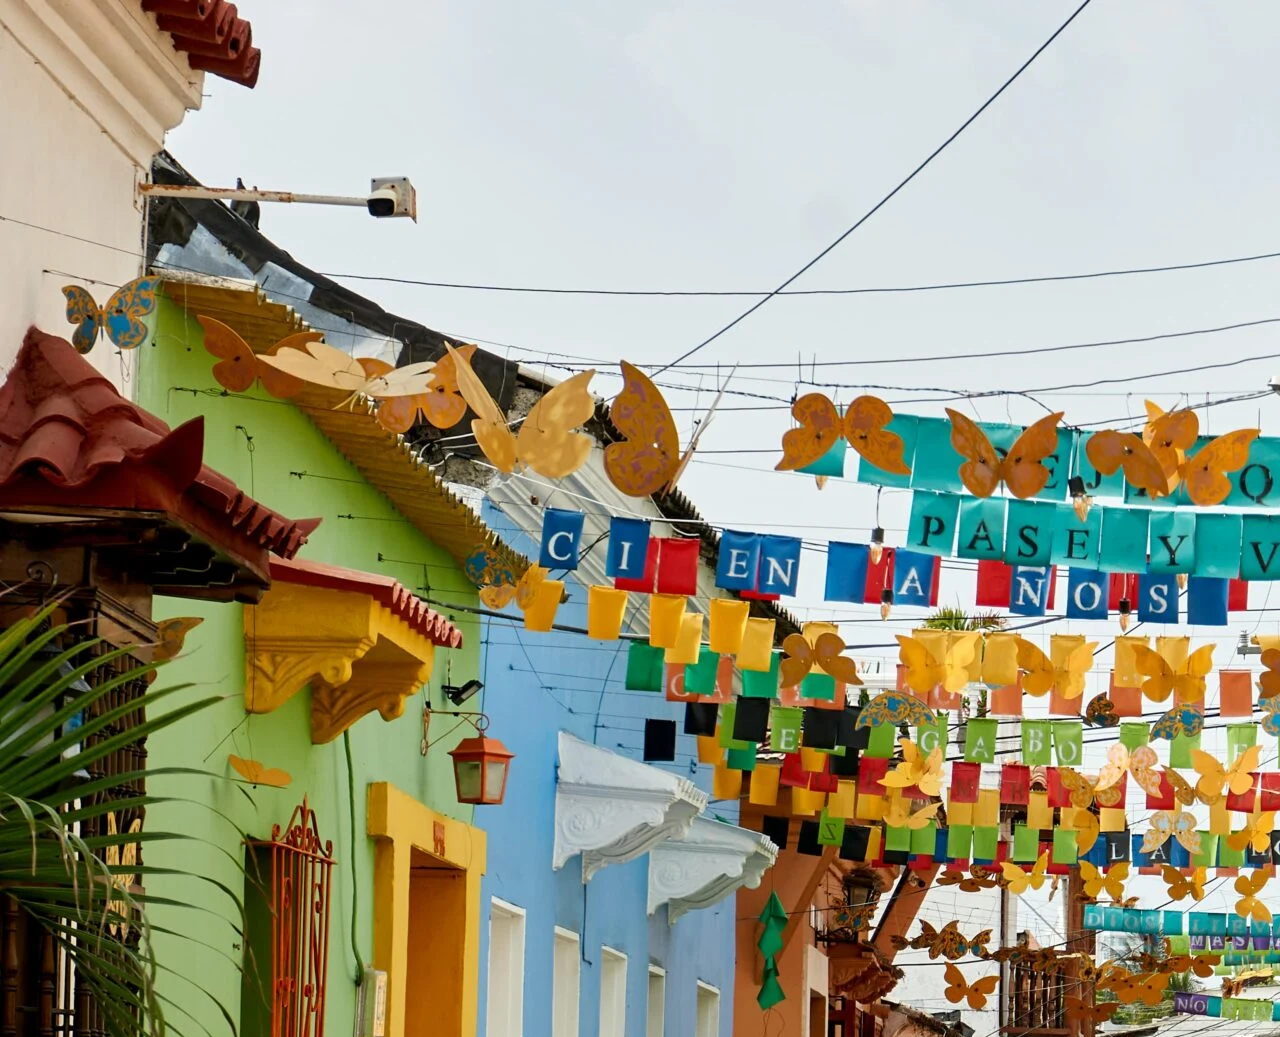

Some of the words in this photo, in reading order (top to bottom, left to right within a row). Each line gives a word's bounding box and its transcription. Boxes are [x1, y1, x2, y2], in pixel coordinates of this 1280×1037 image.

[917, 514, 1090, 560] PASE
[1157, 535, 1190, 567] Y
[548, 530, 796, 586] CIEN
[899, 566, 1168, 614] AÑOS
[921, 728, 1078, 766] GABO
[1110, 842, 1167, 860] LA
[1087, 912, 1157, 930] DIOS
[1177, 997, 1206, 1012] NO
